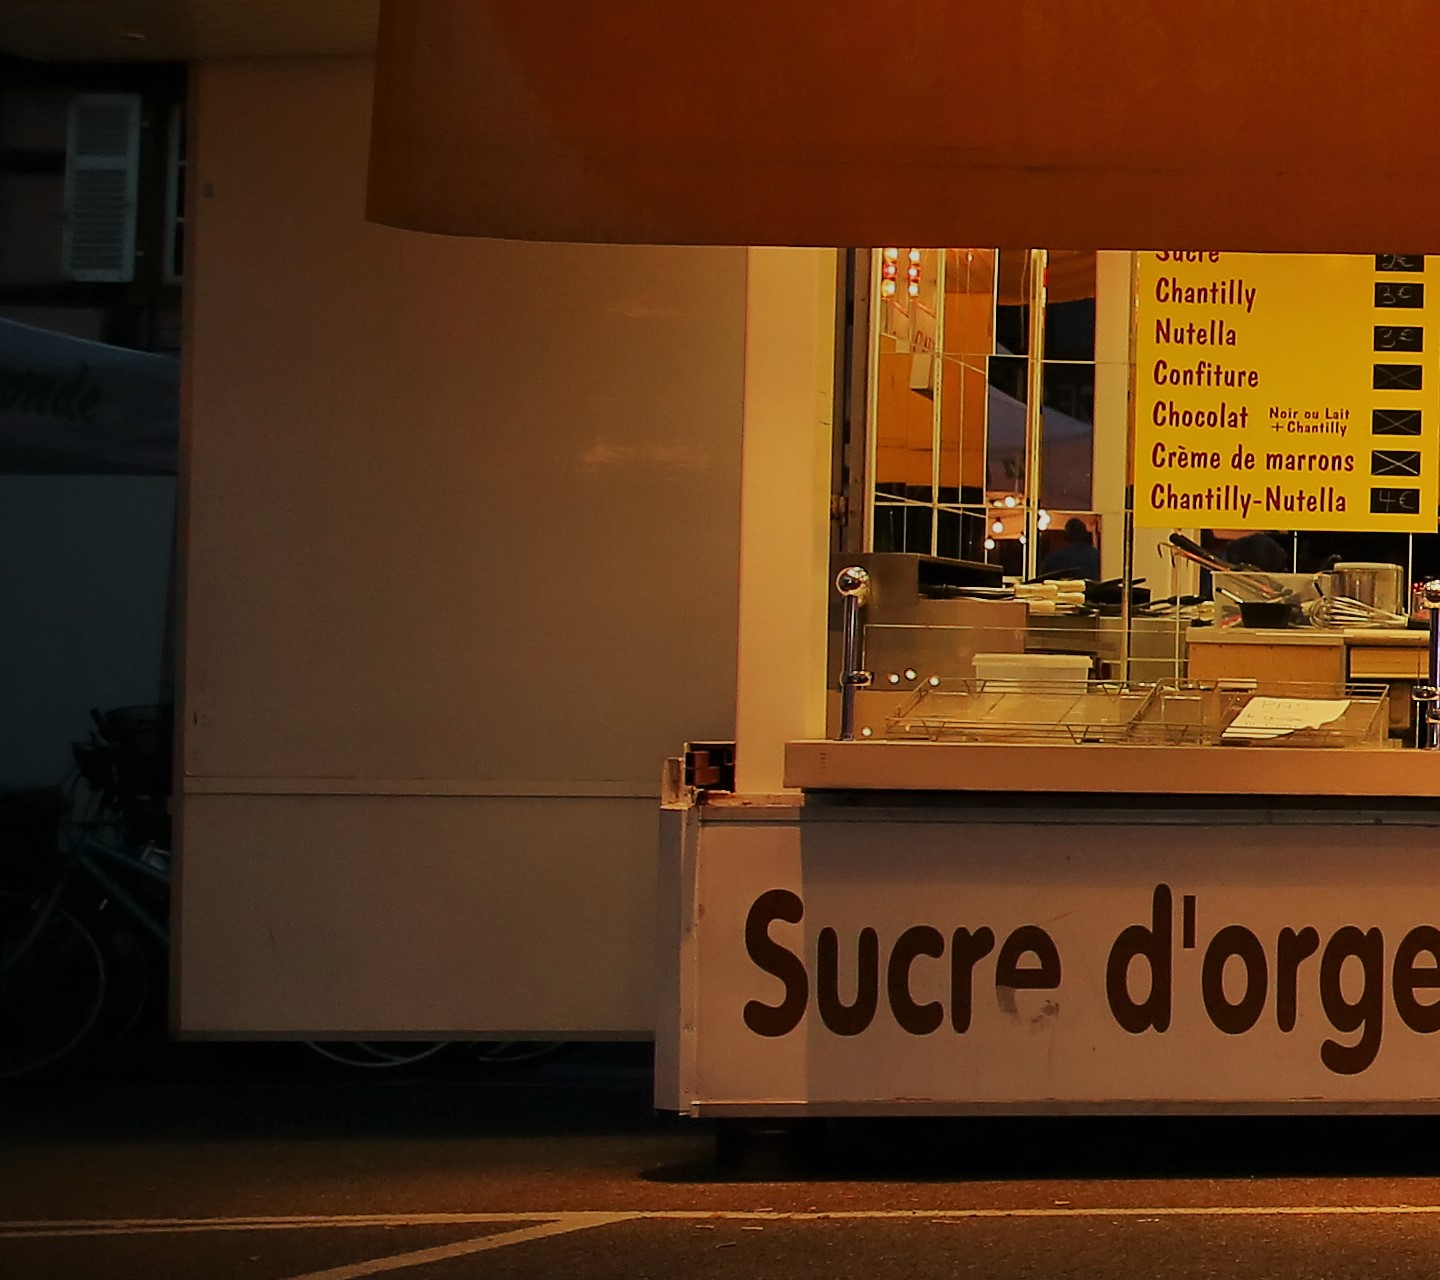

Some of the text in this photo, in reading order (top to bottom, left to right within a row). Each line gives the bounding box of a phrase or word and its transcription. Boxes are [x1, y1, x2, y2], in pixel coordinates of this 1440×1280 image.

[1155, 277, 1257, 313] Chantilly
[1155, 318, 1237, 346] Nutella
[1153, 360, 1260, 389] Confiture
[1152, 401, 1249, 428] Chocolat
[1269, 407, 1350, 420] Noir ou Lait
[1152, 442, 1355, 472] Crème de marrons
[1151, 483, 1347, 519] Chantilly-Nutella
[743, 889, 1062, 1038] Sucre
